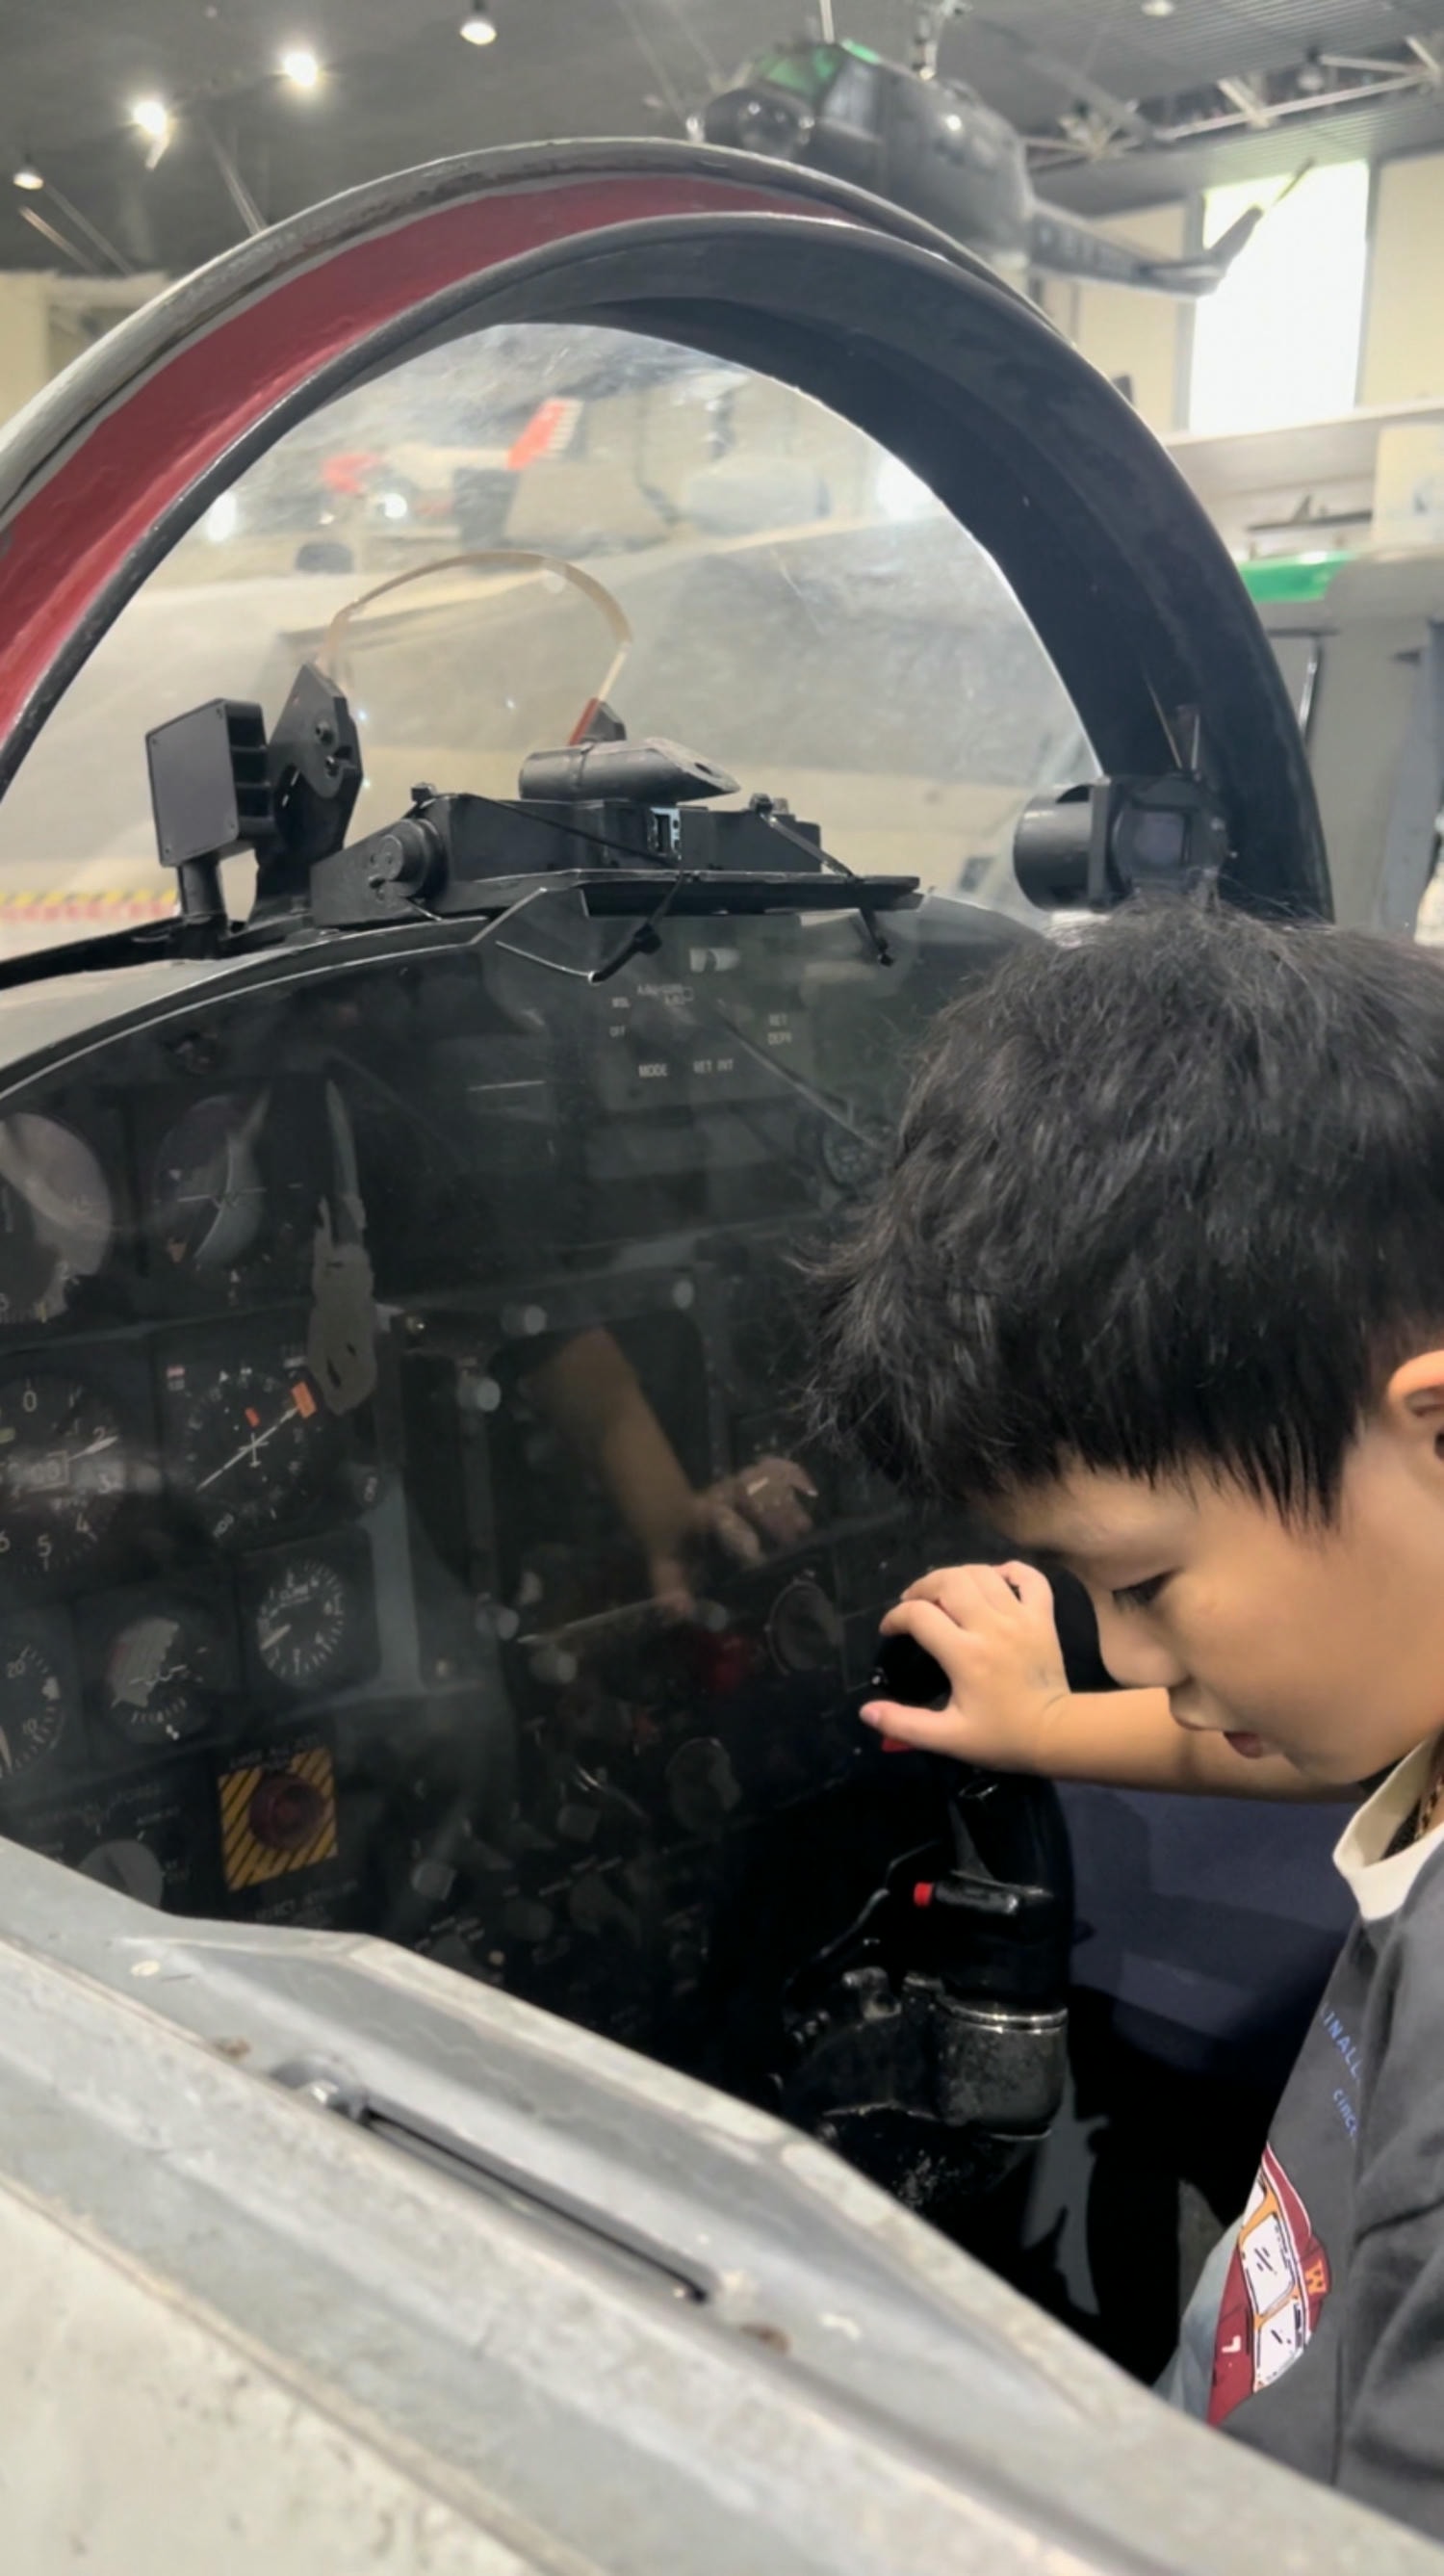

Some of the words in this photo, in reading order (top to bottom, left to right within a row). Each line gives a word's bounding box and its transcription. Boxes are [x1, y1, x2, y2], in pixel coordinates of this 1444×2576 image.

[638, 1063, 668, 1078] MODE
[21, 1390, 38, 1414] 0
[36, 1532, 54, 1557] 5
[1321, 2004, 1362, 2088] INALL
